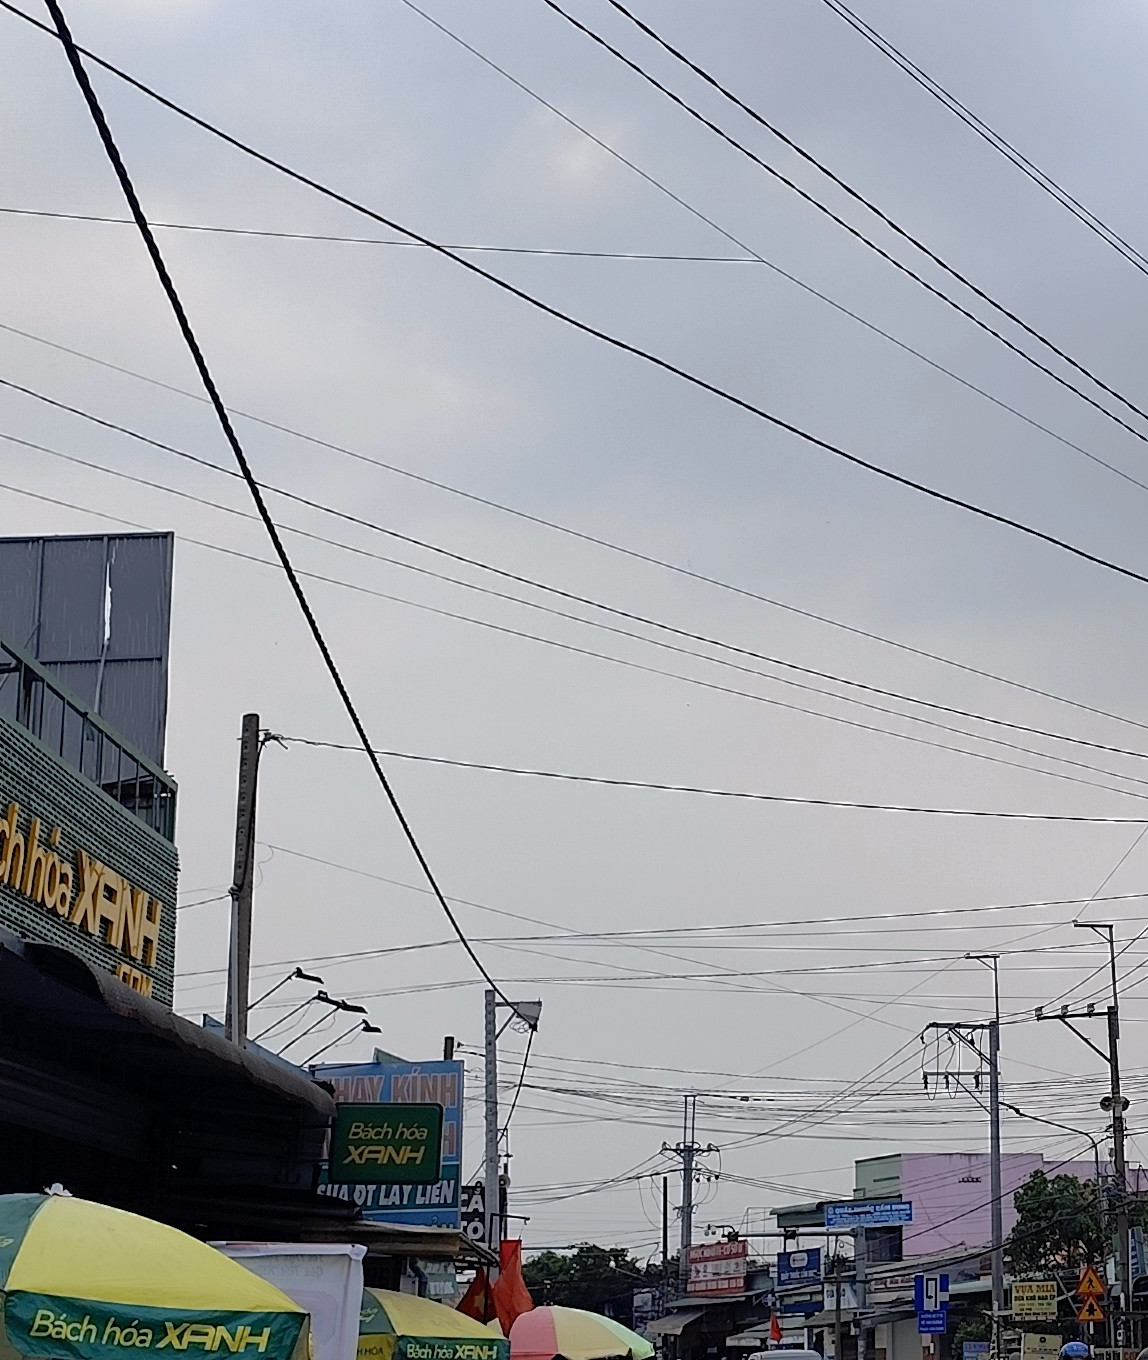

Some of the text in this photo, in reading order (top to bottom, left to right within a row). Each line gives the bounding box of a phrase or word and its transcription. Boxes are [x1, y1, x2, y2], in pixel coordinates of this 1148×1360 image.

[69, 849, 163, 970] XANH
[333, 1074, 386, 1104] HAY
[348, 1121, 394, 1140] Bách
[395, 1121, 430, 1140] hóa
[342, 1144, 426, 1165] XANH
[29, 1308, 273, 1353] Bách hóa XANH
[407, 1343, 435, 1360] Bách
[434, 1345, 454, 1360] hóa
